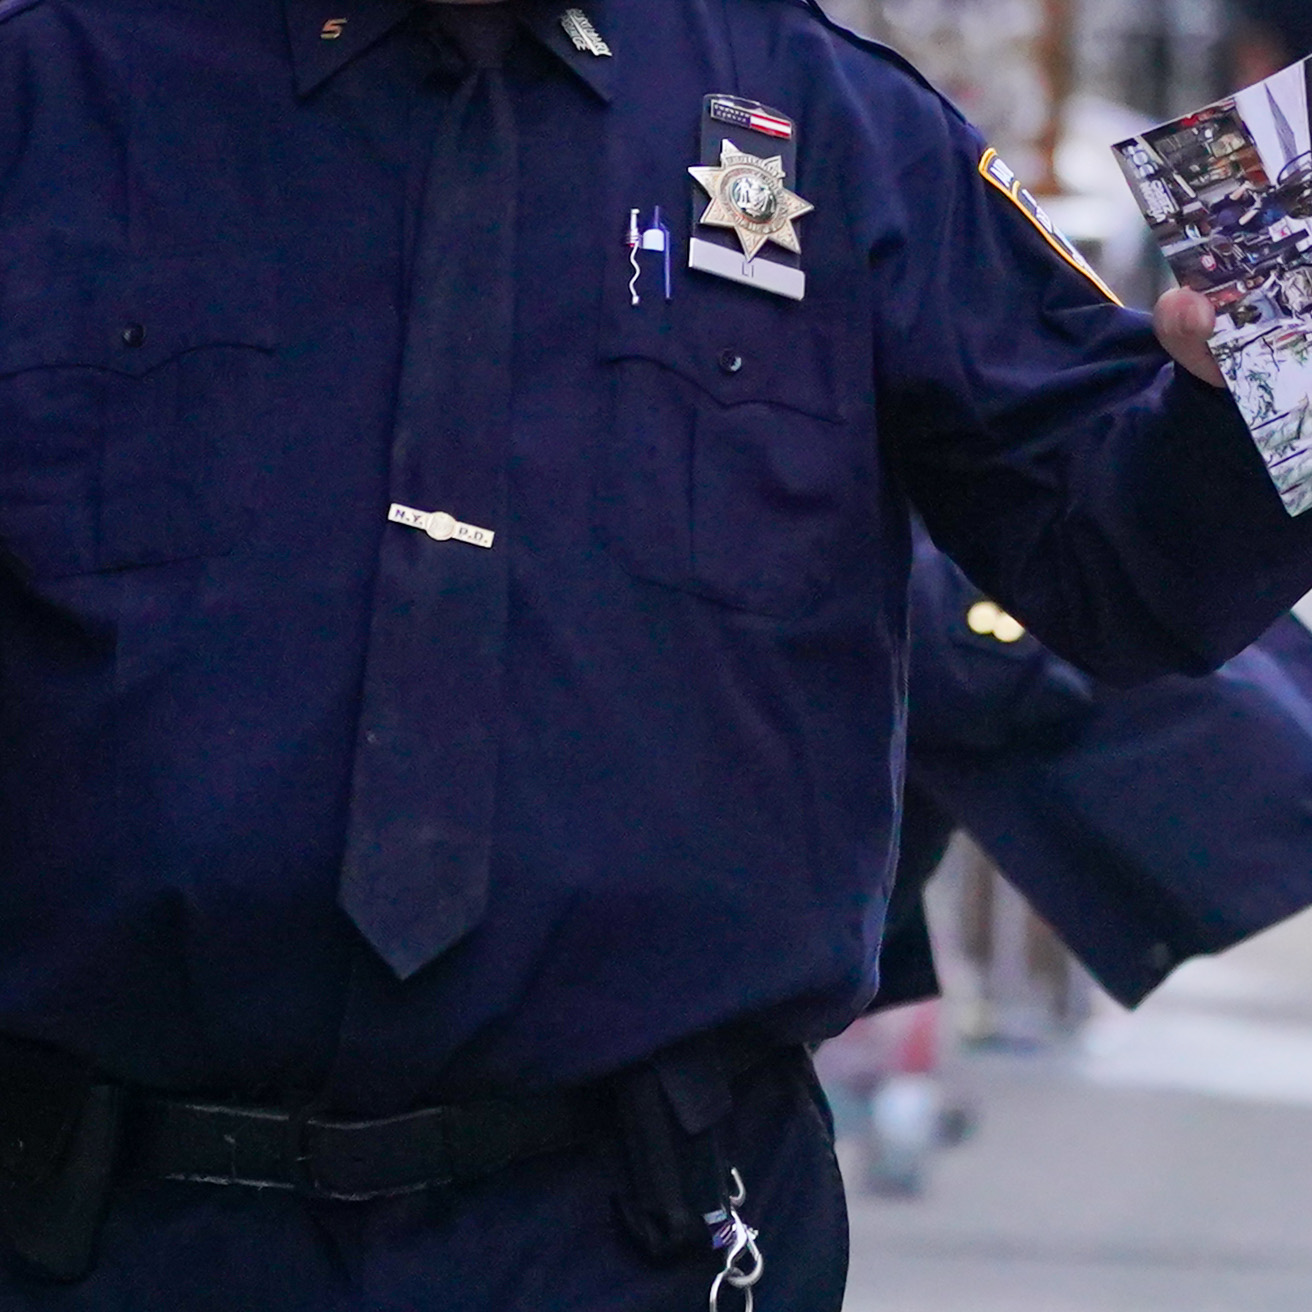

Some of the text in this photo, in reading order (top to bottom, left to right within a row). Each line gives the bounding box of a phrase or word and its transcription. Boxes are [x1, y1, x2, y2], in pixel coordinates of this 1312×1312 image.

[741, 261, 754, 278] LI
[394, 508, 489, 544] N.Y. P.D.
